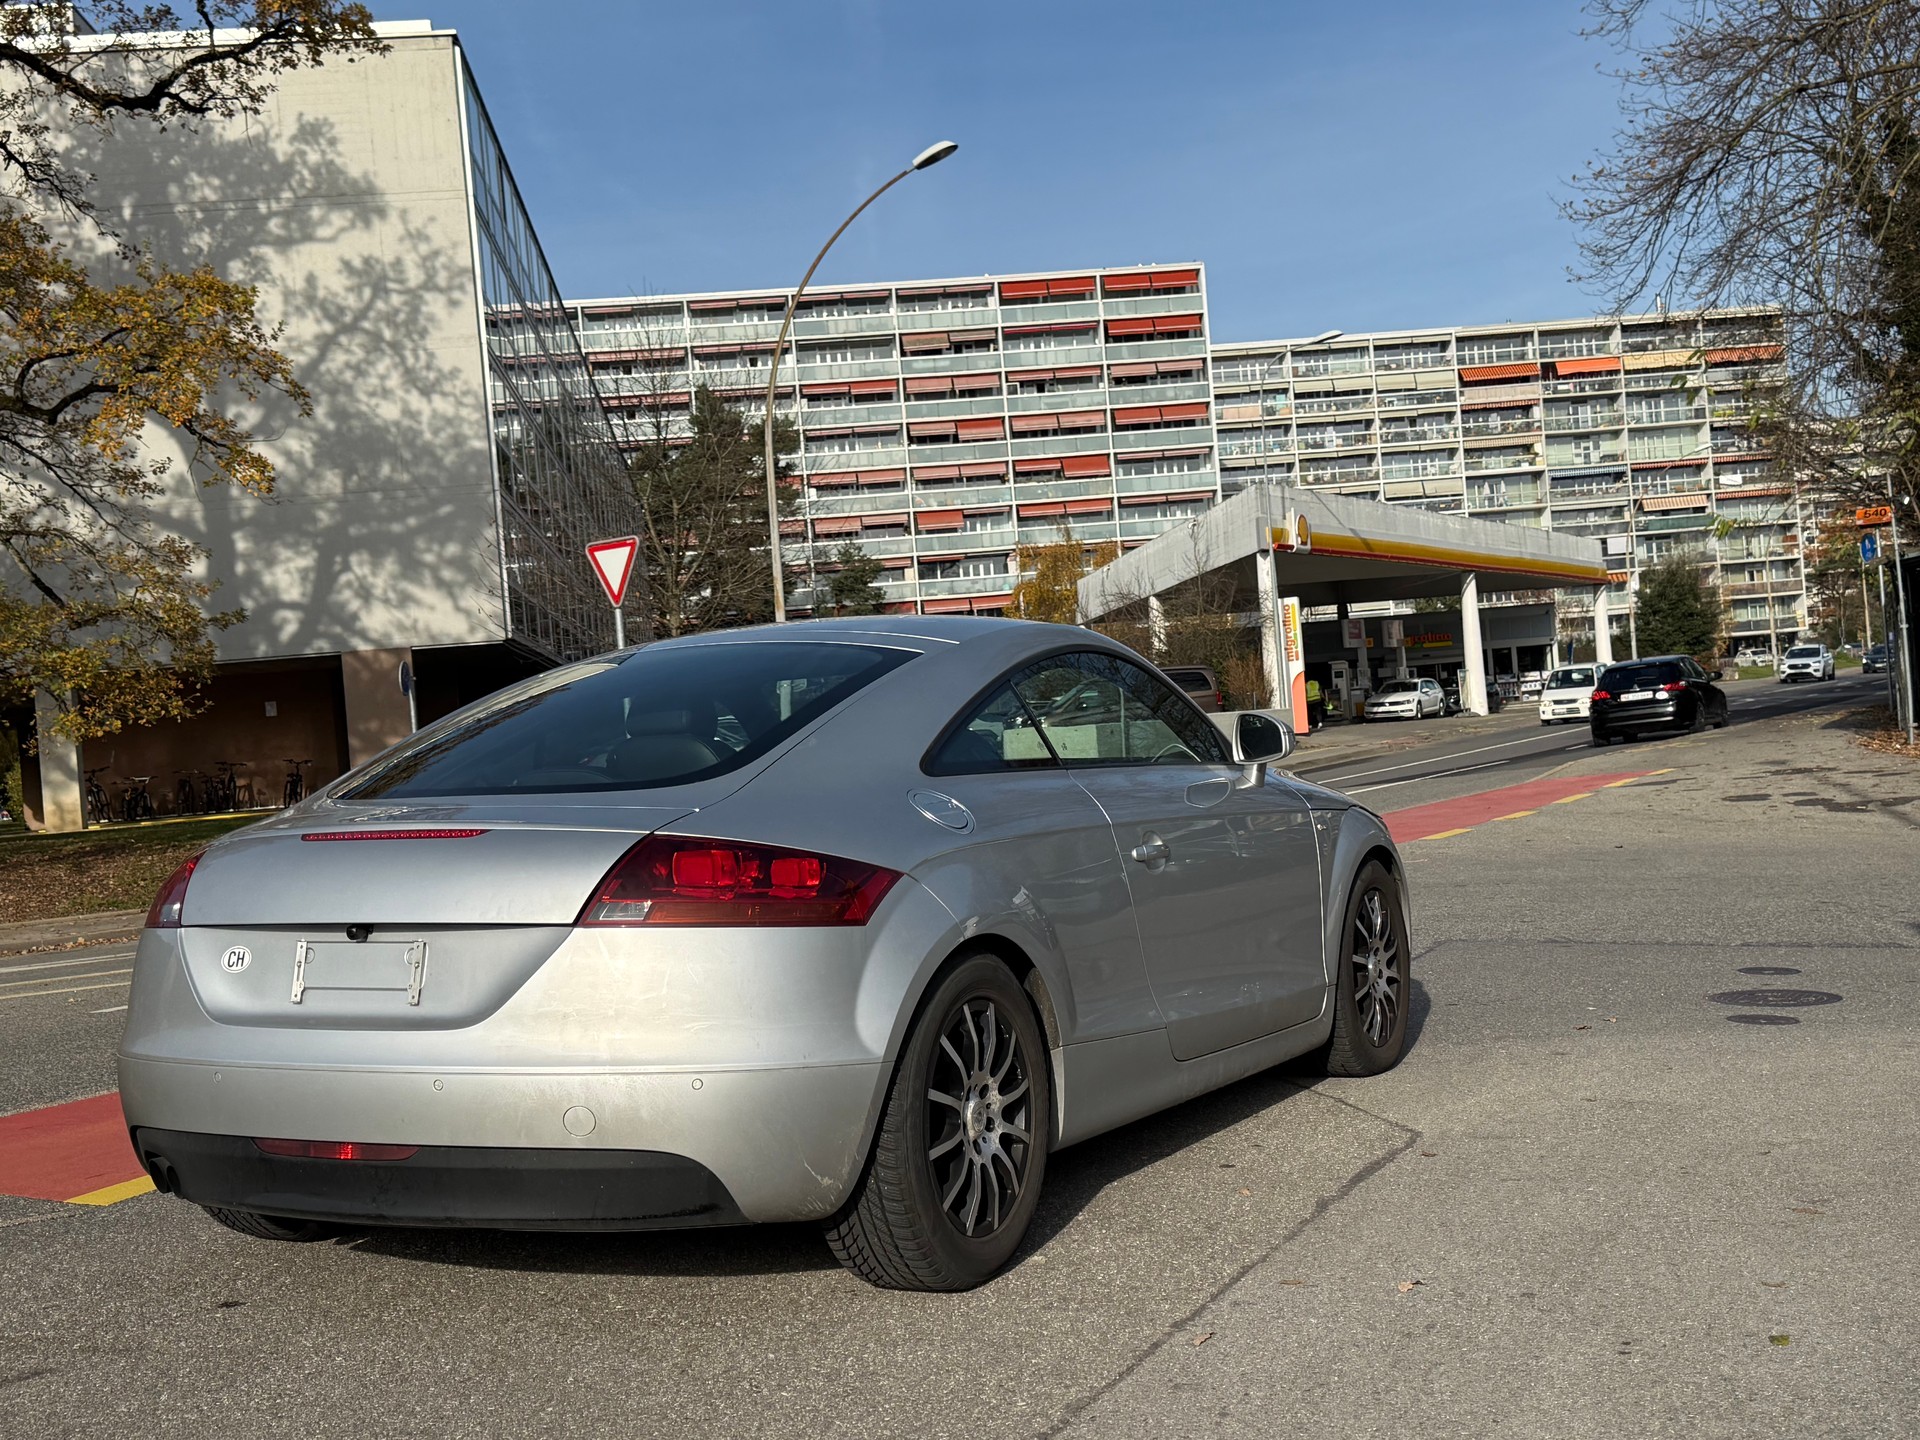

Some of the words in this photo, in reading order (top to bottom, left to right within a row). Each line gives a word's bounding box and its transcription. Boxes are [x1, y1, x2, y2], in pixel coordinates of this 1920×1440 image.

[1864, 508, 1887, 518] 540
[1282, 604, 1296, 662] migrolino
[227, 950, 246, 968] CH
